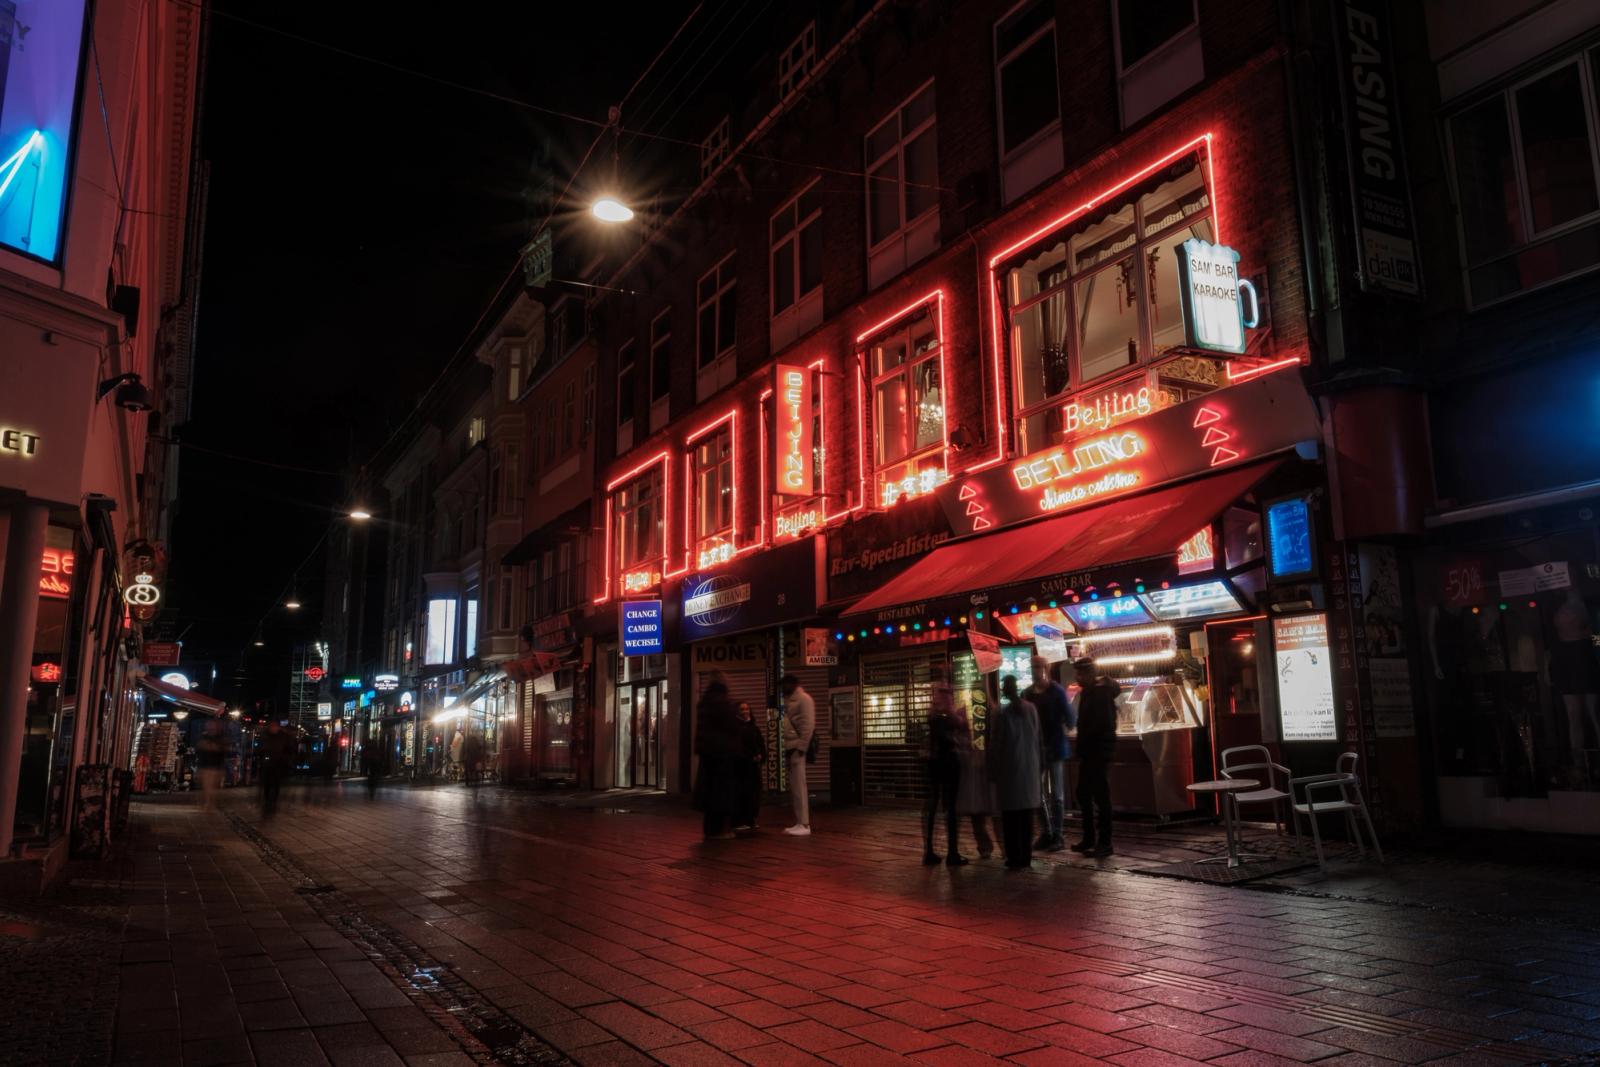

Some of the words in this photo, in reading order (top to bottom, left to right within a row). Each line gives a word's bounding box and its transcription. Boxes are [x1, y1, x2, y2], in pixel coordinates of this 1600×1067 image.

[1344, 0, 1396, 180] EASING
[1215, 264, 1234, 279] BAR
[1193, 282, 1237, 302] KARAOKE
[1063, 387, 1152, 434] Beijing
[786, 371, 803, 488] BEIJING
[1012, 432, 1141, 491] BEIJING
[1039, 486, 1086, 511] chinese
[1088, 471, 1138, 496] cuisine
[776, 510, 816, 538] Beijing
[1040, 577, 1069, 594] SAMS
[1070, 573, 1092, 590] BAR
[709, 583, 750, 608] EXCHANGE
[626, 610, 657, 619] CHANGE
[627, 624, 658, 633] CAMBIO
[625, 638, 660, 648] WECHSEL
[808, 655, 838, 665] AMBER
